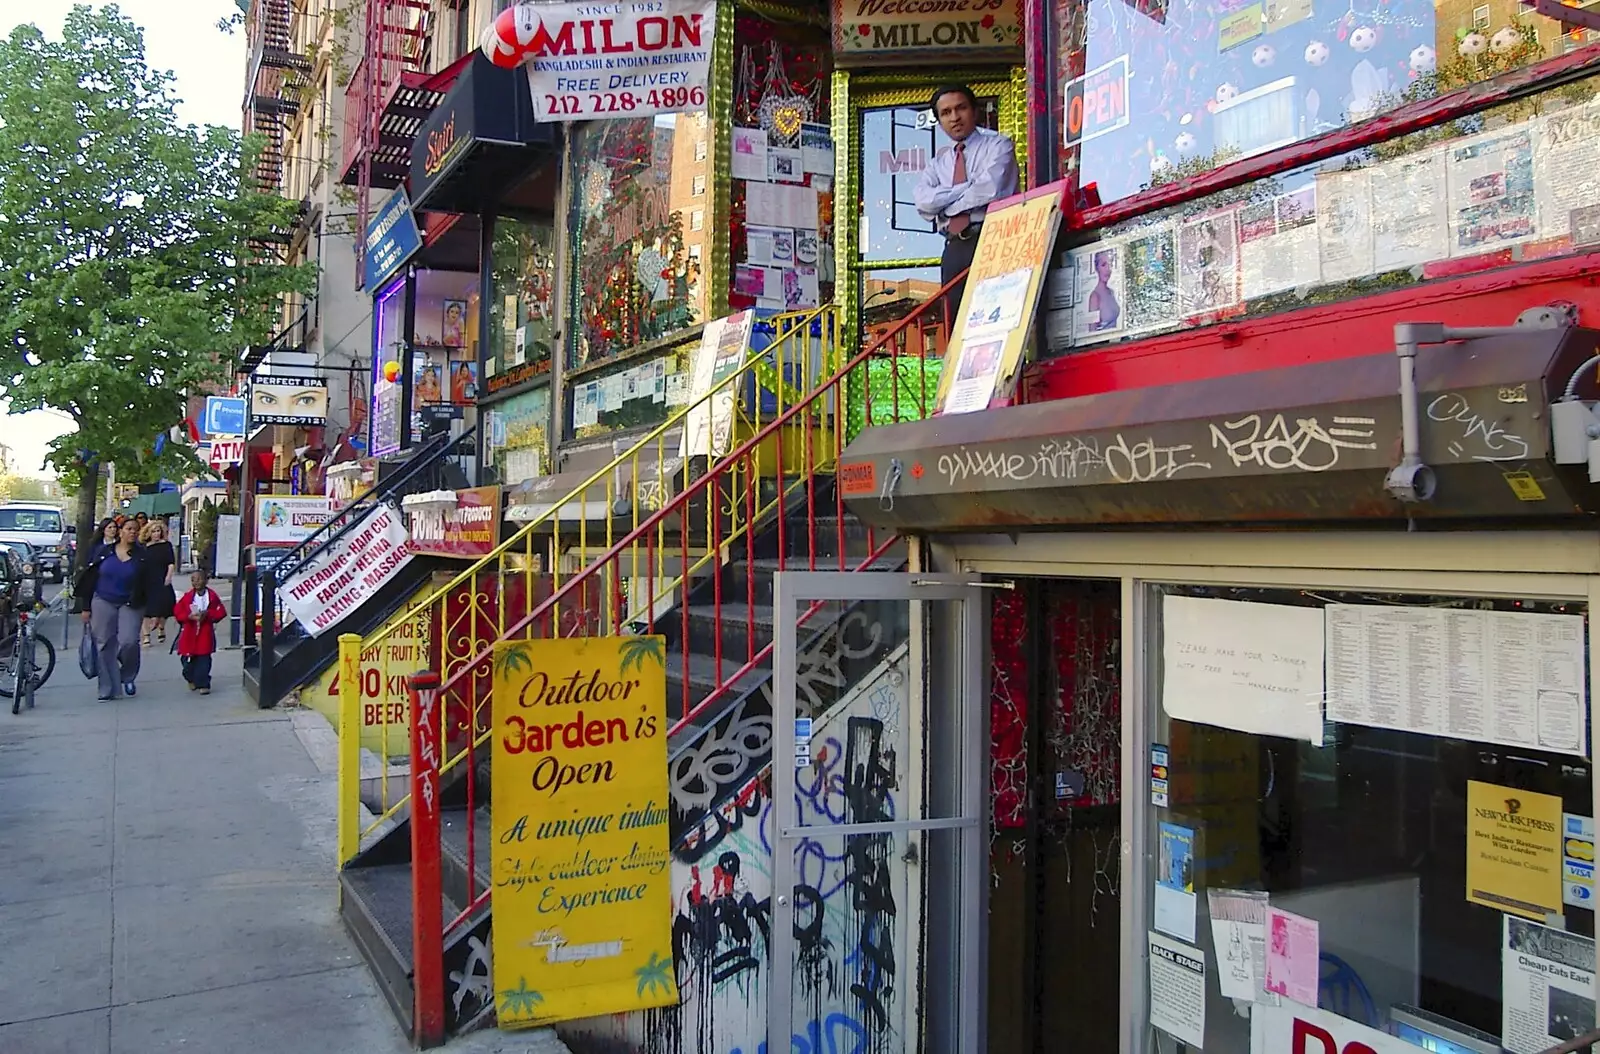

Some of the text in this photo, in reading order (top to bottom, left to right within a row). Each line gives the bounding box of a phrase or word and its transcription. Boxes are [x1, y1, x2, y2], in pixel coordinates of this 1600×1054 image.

[576, 2, 663, 16] SINCE 1982
[535, 14, 704, 58] MILON
[872, 21, 980, 48] MILON
[533, 52, 707, 71] BANGLADESHI & INDIAN RESTAURANT
[557, 71, 689, 91] FREE DELIVERY
[545, 95, 583, 115] 212
[1069, 77, 1123, 134] OPEN
[256, 376, 300, 385] PERFECT
[222, 406, 243, 415] Phone
[212, 442, 245, 461] ATM
[290, 552, 348, 601] THREADING
[349, 528, 373, 556] HAIR
[372, 512, 393, 535] CUT
[316, 538, 392, 606] FACIAL HENNA
[312, 586, 362, 630] WAXING
[518, 669, 640, 708] Outdoor
[365, 702, 404, 726] BEER
[634, 704, 656, 739] is
[532, 756, 616, 798] Open
[500, 800, 670, 844] A unique indian
[1474, 808, 1555, 833] NEW YORK PRESS
[1475, 830, 1554, 853] Best Indian Restaurant
[1492, 841, 1537, 856] With Garden
[1570, 867, 1591, 878] VISA
[537, 883, 647, 918] Experience
[1152, 945, 1202, 972] BACK STAGE
[1519, 956, 1590, 985] Cheap Eats East
